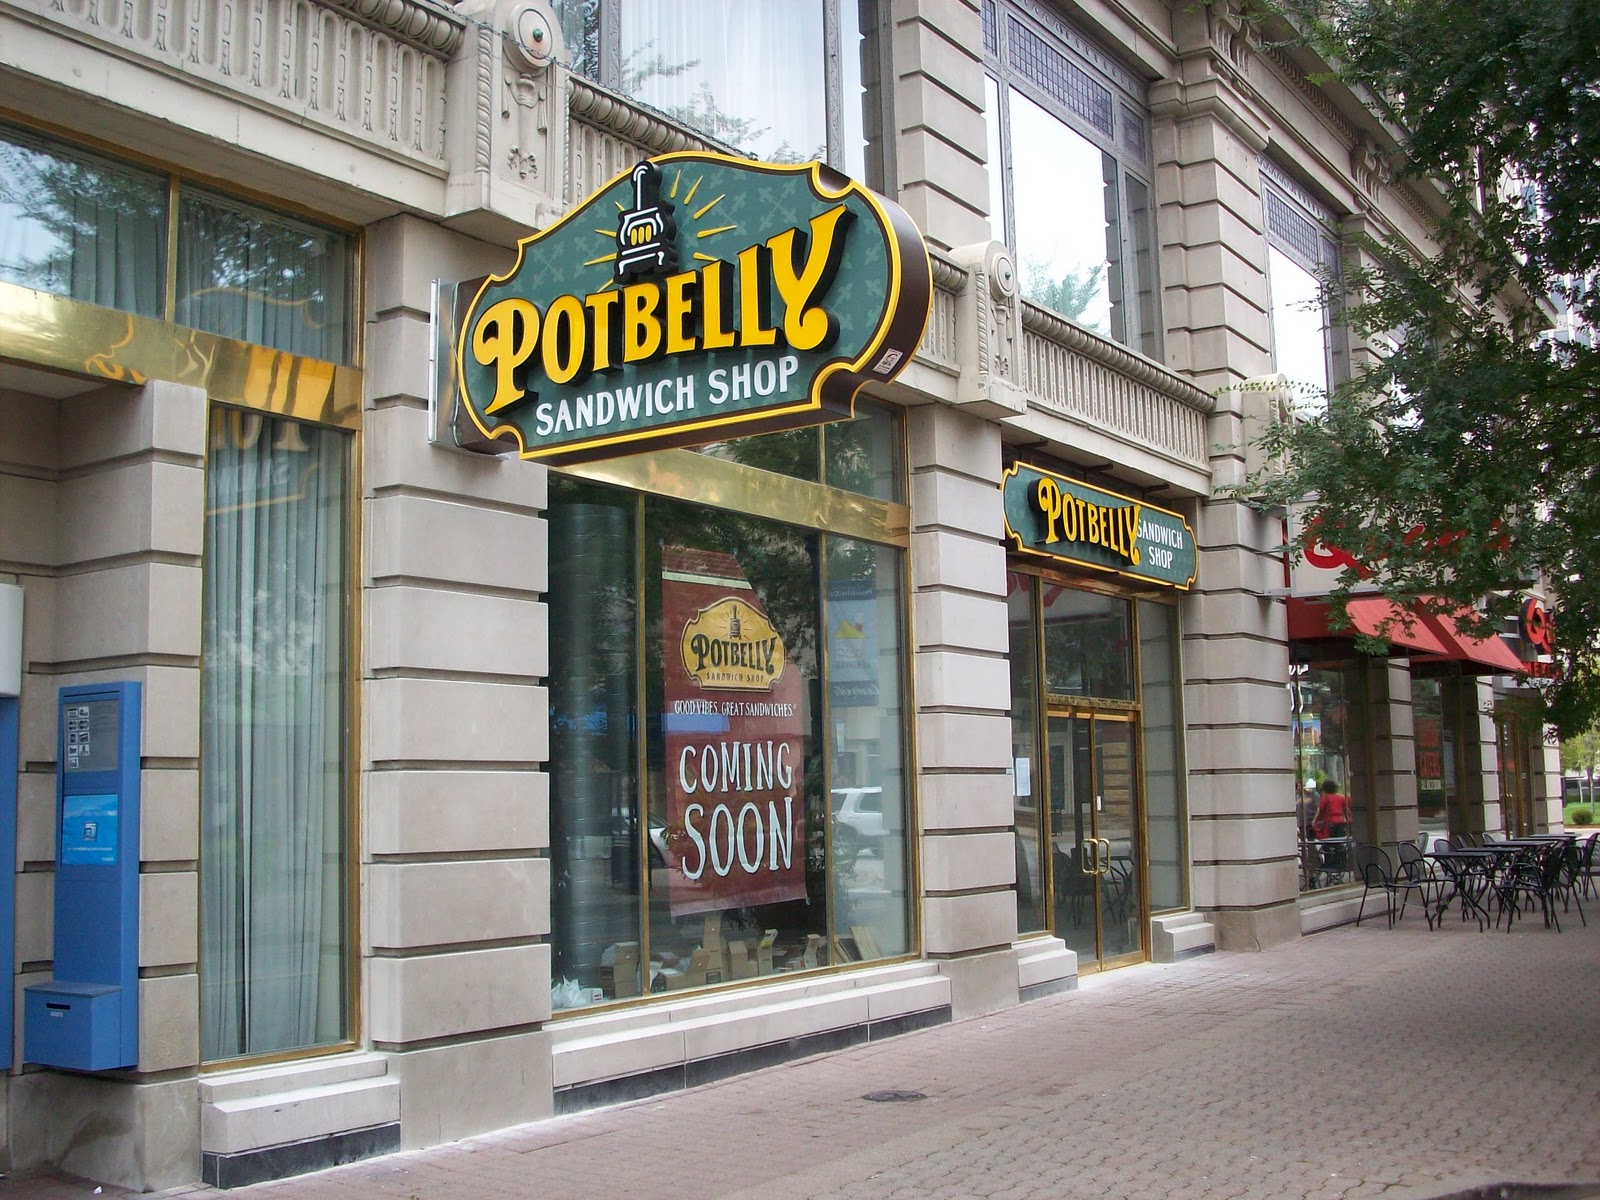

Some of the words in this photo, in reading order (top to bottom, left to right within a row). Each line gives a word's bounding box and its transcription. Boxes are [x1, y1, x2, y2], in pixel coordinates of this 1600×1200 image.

[472, 204, 848, 415] POTBELLY
[535, 375, 695, 436] SANDWICH
[708, 355, 799, 404] SHOP
[1037, 476, 1141, 566] POTBELLY
[1137, 519, 1183, 550] SANDWICH
[1148, 546, 1173, 570] SHOP
[690, 633, 778, 675] POTBELLY
[706, 672, 744, 682] SANDWICH
[746, 674, 764, 683] SHOP
[674, 700, 696, 715] GOOD
[696, 701, 719, 716] VIBES.
[721, 702, 746, 716] GREAT
[679, 740, 793, 794] COMING
[681, 796, 793, 880] SOON
